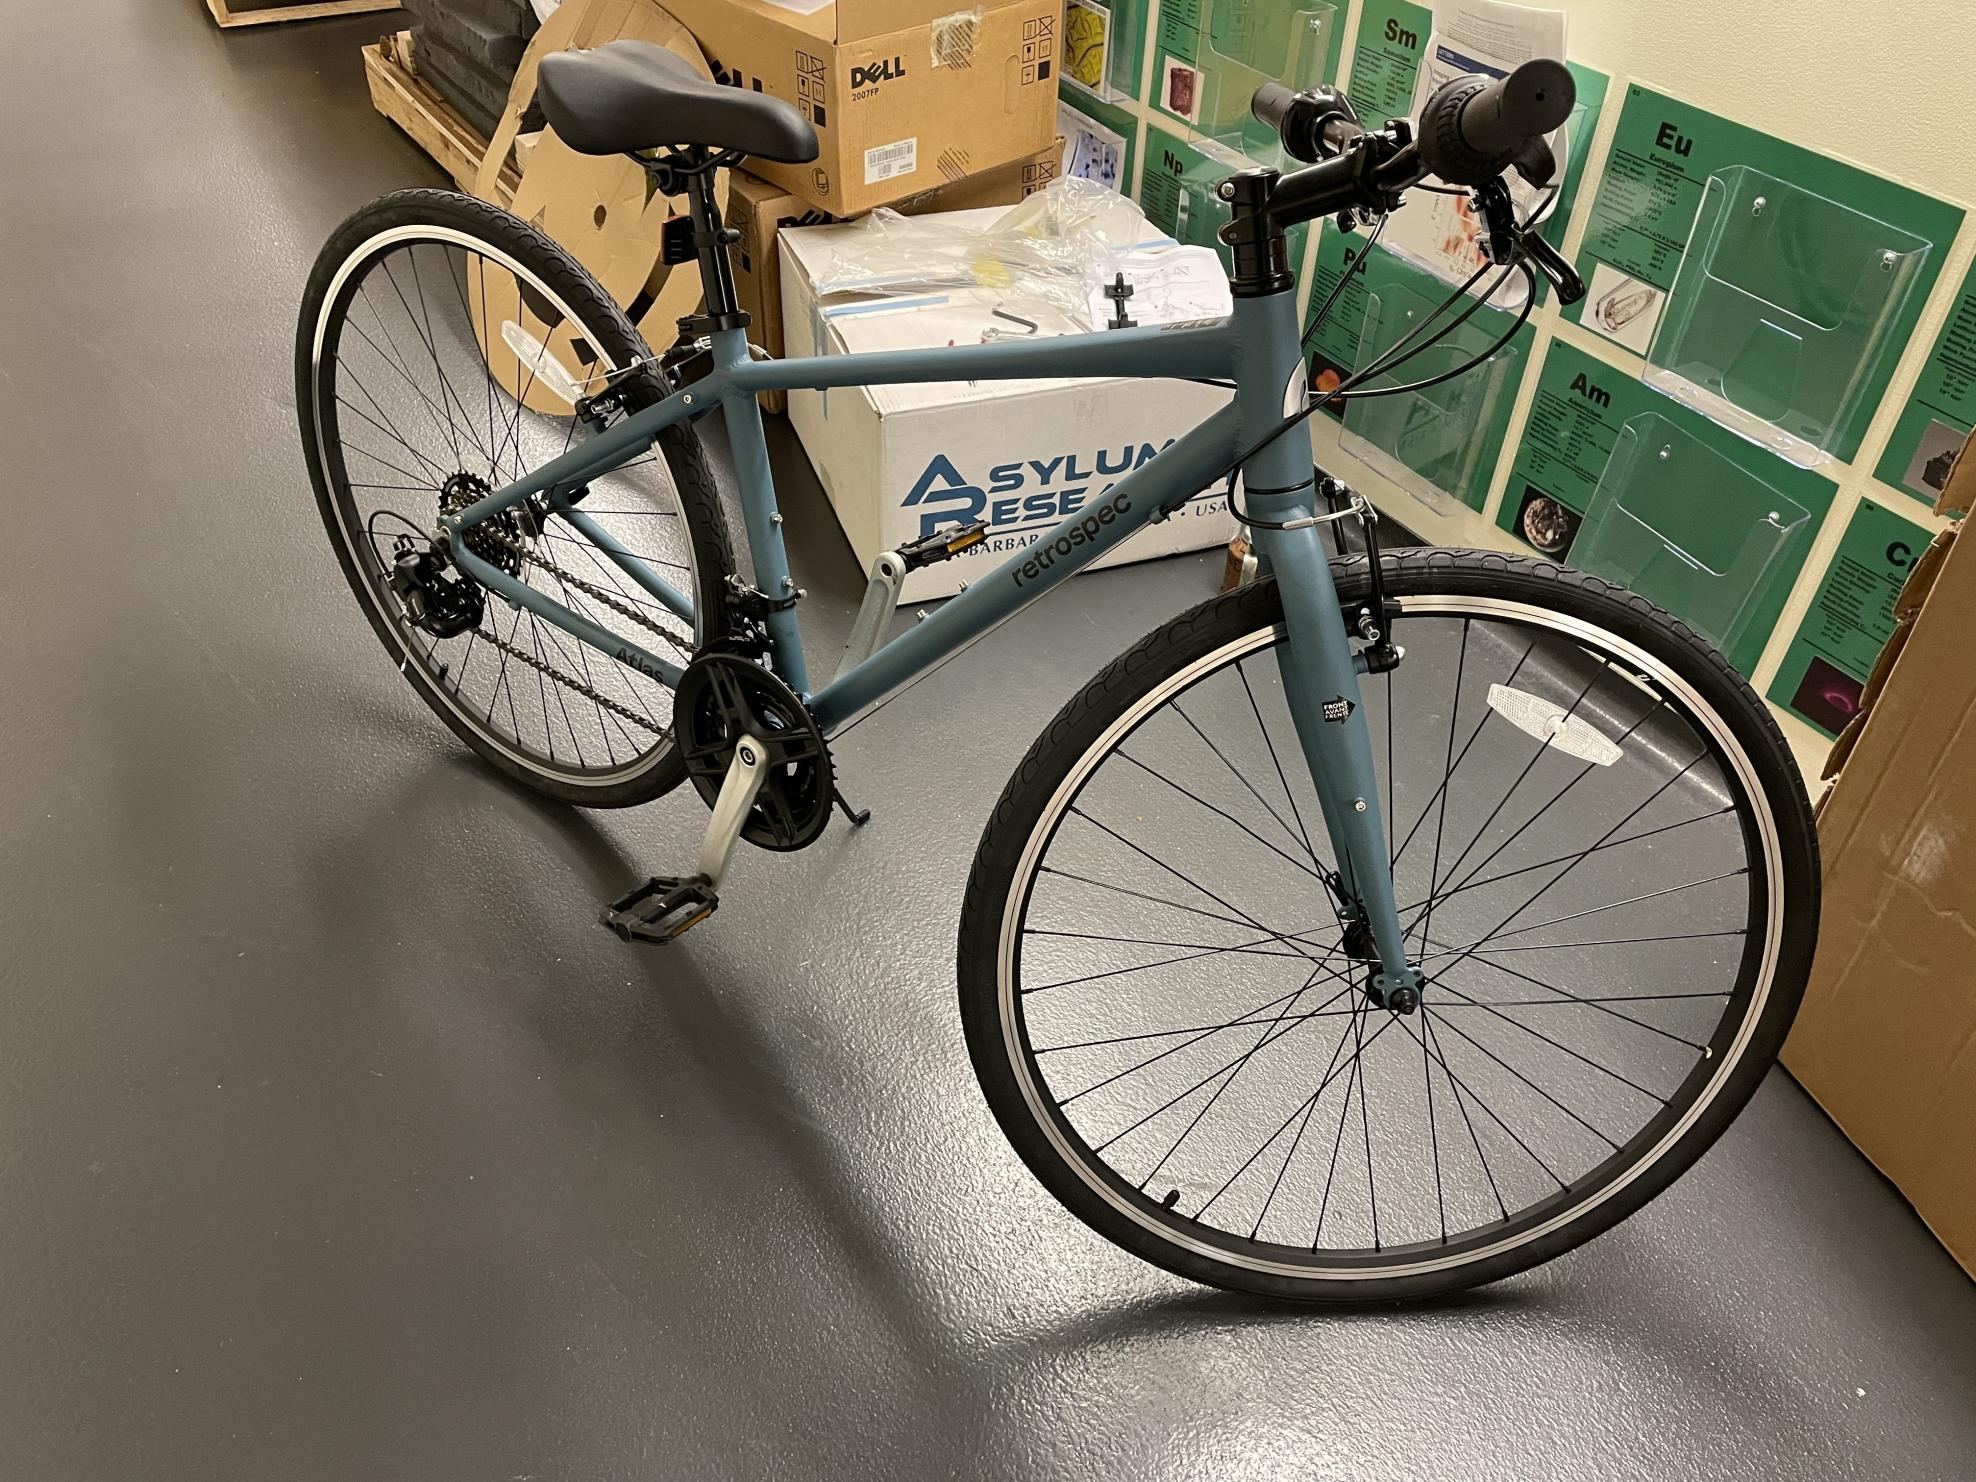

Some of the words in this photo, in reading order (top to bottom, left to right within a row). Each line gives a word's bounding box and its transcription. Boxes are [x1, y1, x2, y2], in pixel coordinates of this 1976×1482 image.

[1384, 18, 1417, 50] Sm
[850, 56, 906, 90] DELL
[851, 87, 880, 102] 2007FP
[1655, 121, 1694, 158] Eu
[1163, 149, 1184, 177] Np
[1569, 372, 1611, 409] Am
[900, 438, 1176, 507] ASYLUM
[920, 482, 1115, 539] RESE
[968, 533, 1040, 557] BARBAR
[1195, 500, 1228, 517] USA
[1011, 493, 1132, 589] retrospec
[615, 646, 664, 684] Atlas
[1323, 700, 1348, 711] FRONT
[1325, 705, 1349, 715] AVANT
